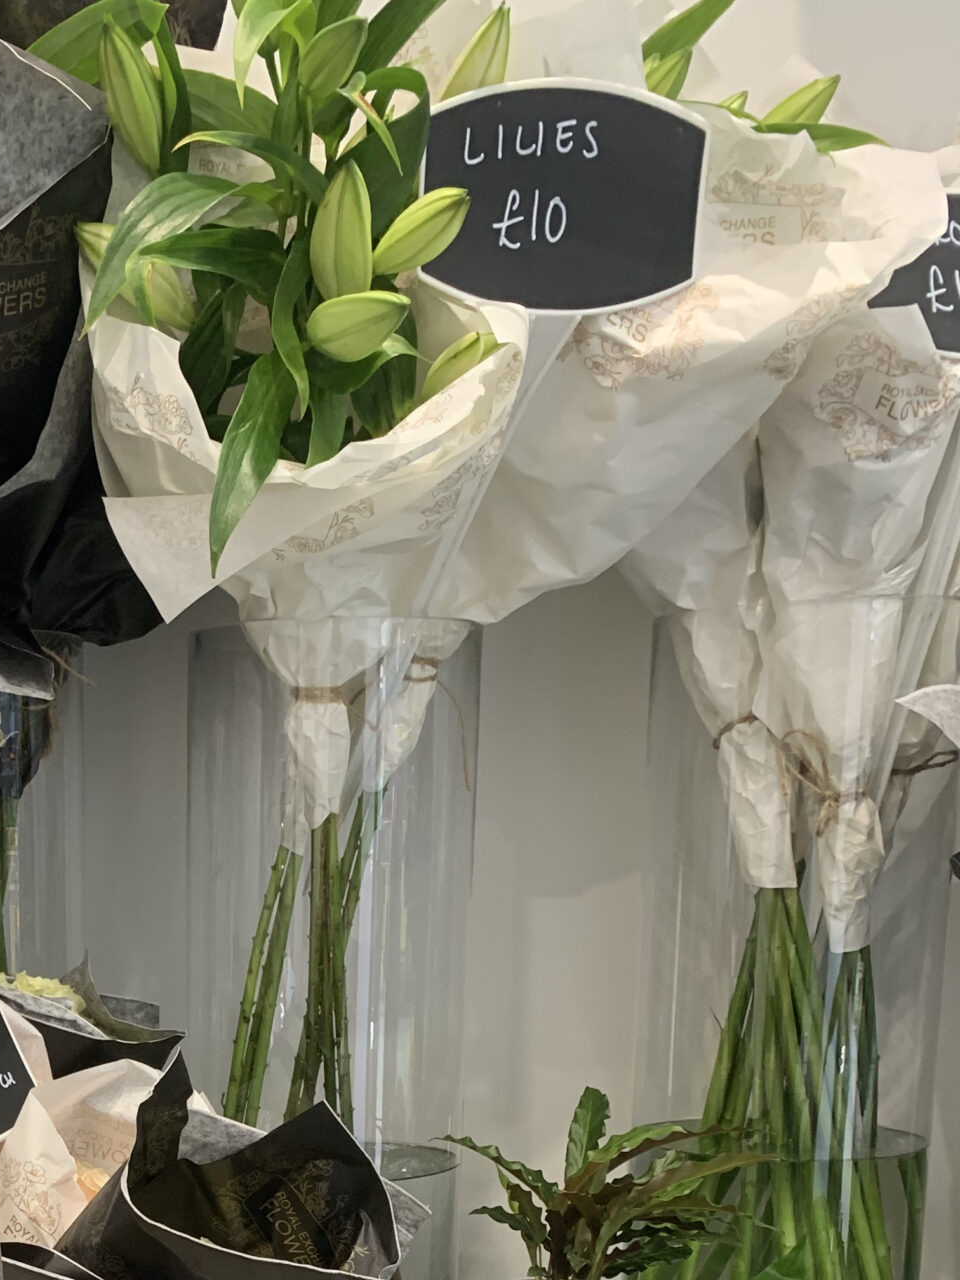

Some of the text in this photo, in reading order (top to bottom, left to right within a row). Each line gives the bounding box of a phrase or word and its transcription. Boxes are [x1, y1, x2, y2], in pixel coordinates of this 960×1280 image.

[463, 118, 599, 165] LILIES
[198, 158, 233, 174] ROYAL
[492, 188, 567, 249] £10
[719, 215, 777, 232] CHANGE
[273, 1191, 302, 1230] ROYAL
